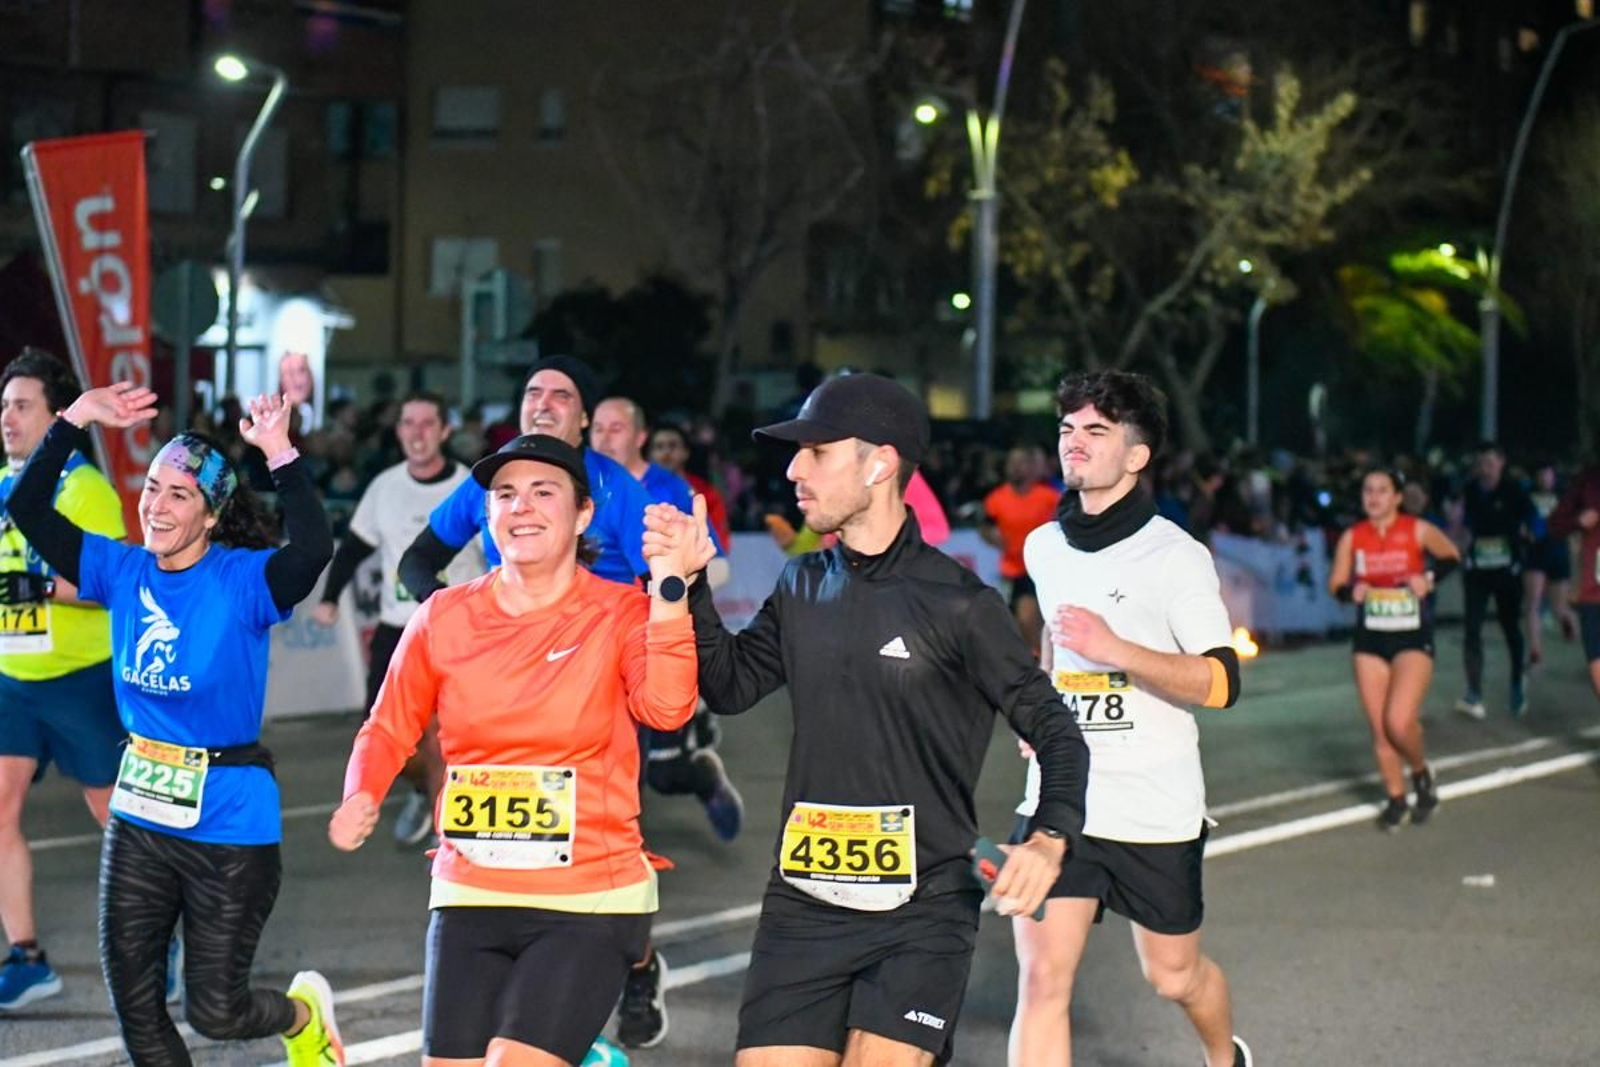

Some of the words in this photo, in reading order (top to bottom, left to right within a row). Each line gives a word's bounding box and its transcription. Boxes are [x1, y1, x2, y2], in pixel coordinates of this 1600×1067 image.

[122, 666, 192, 691] GACELAS
[121, 755, 196, 799] 2225
[453, 794, 560, 829] 3155
[789, 835, 901, 872] 4356
